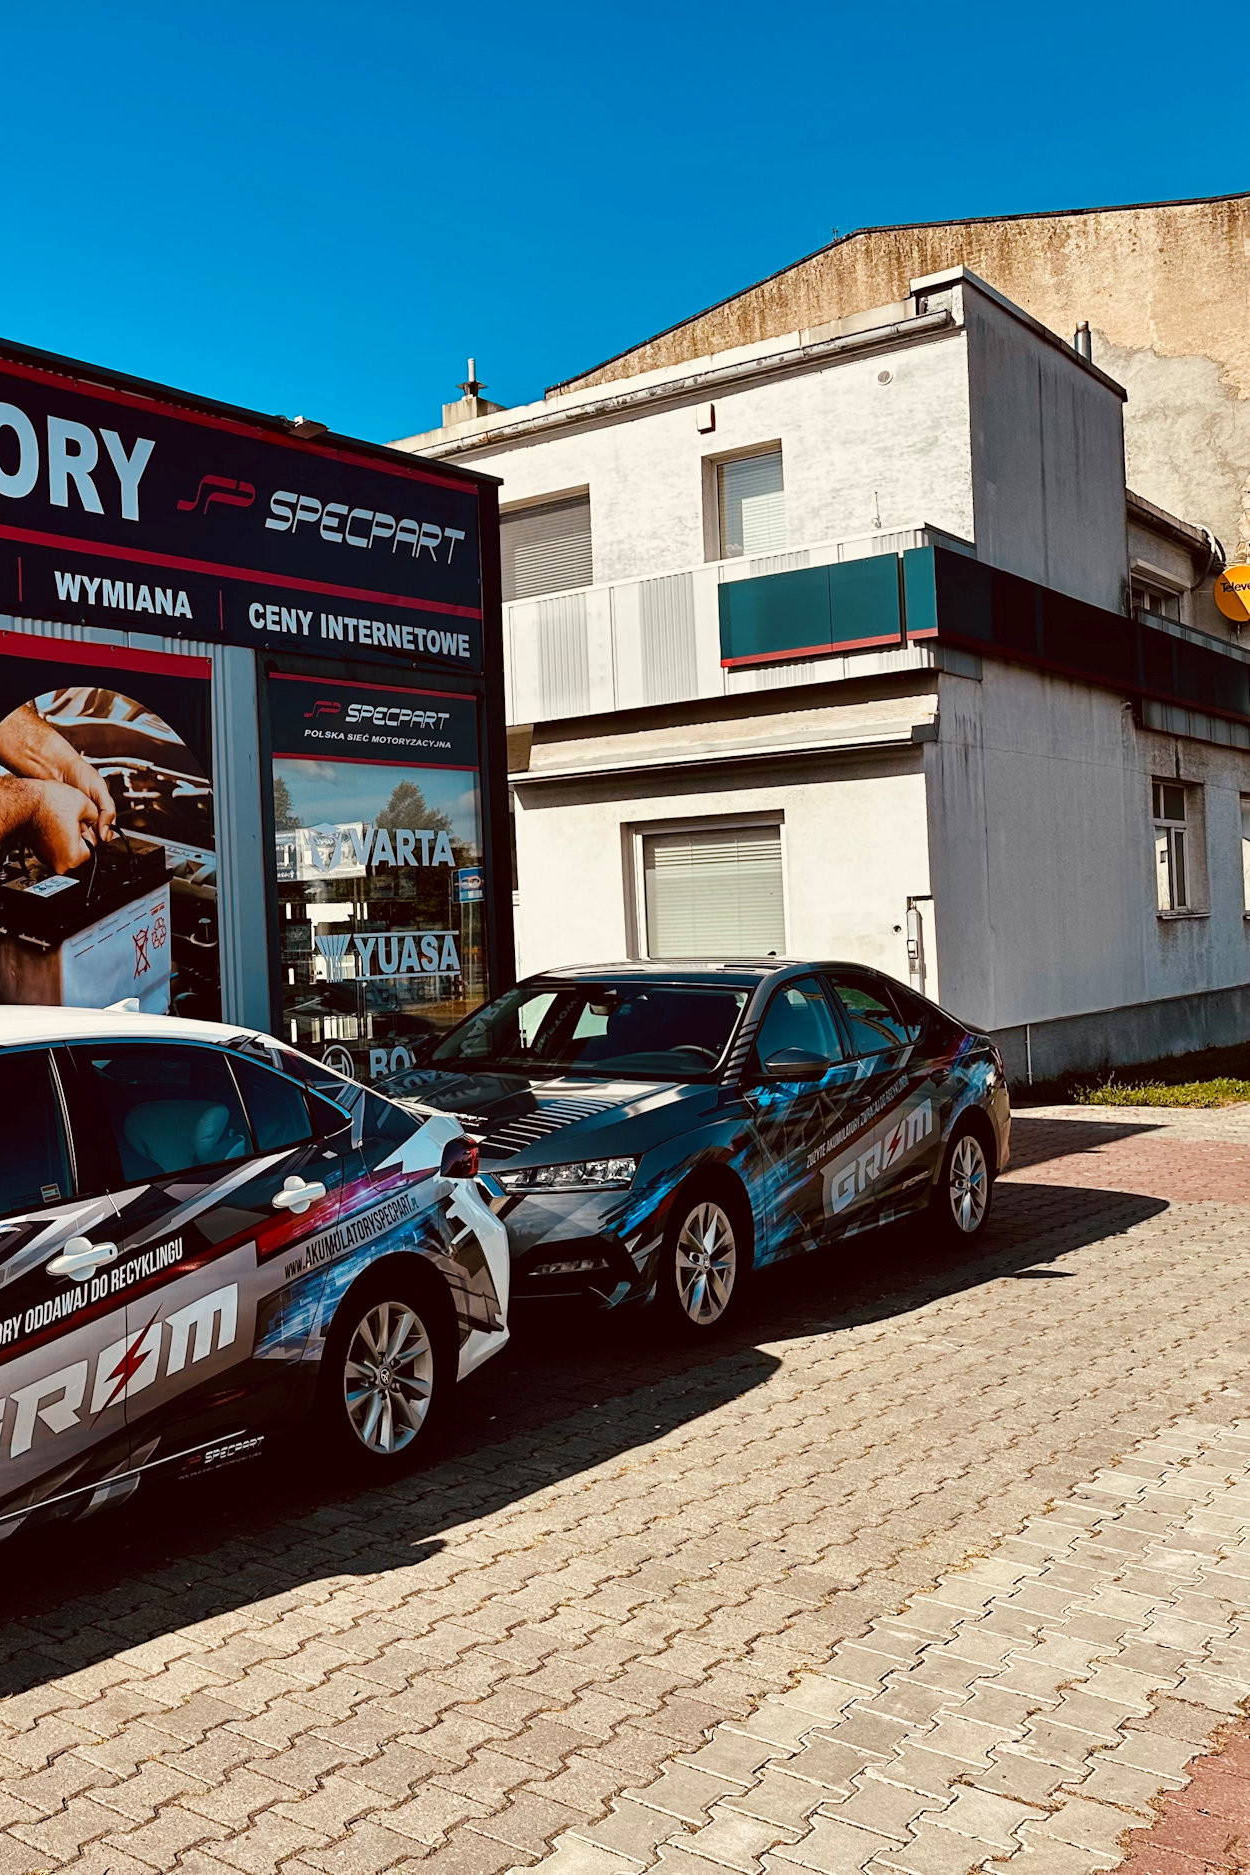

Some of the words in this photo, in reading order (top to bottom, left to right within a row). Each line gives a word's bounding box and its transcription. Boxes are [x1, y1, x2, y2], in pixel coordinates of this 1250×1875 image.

[265, 491, 465, 564] SPECPART
[54, 571, 192, 618] WYMIANA
[249, 603, 313, 635] CENY
[321, 614, 470, 657] INTERNETOWE
[304, 729, 345, 741] POLSKA
[347, 732, 370, 744] SIEĆ
[371, 736, 452, 749] MOTORYZACYJNA
[346, 704, 450, 730] SPECPART
[350, 828, 455, 867] VARTA
[355, 934, 460, 975] YUASA
[370, 1046, 416, 1079] BO
[831, 1098, 932, 1214] GROM
[24, 1283, 89, 1334] ODDAWAJ
[90, 1274, 108, 1306] DO
[110, 1237, 184, 1293] RECYKLINGU
